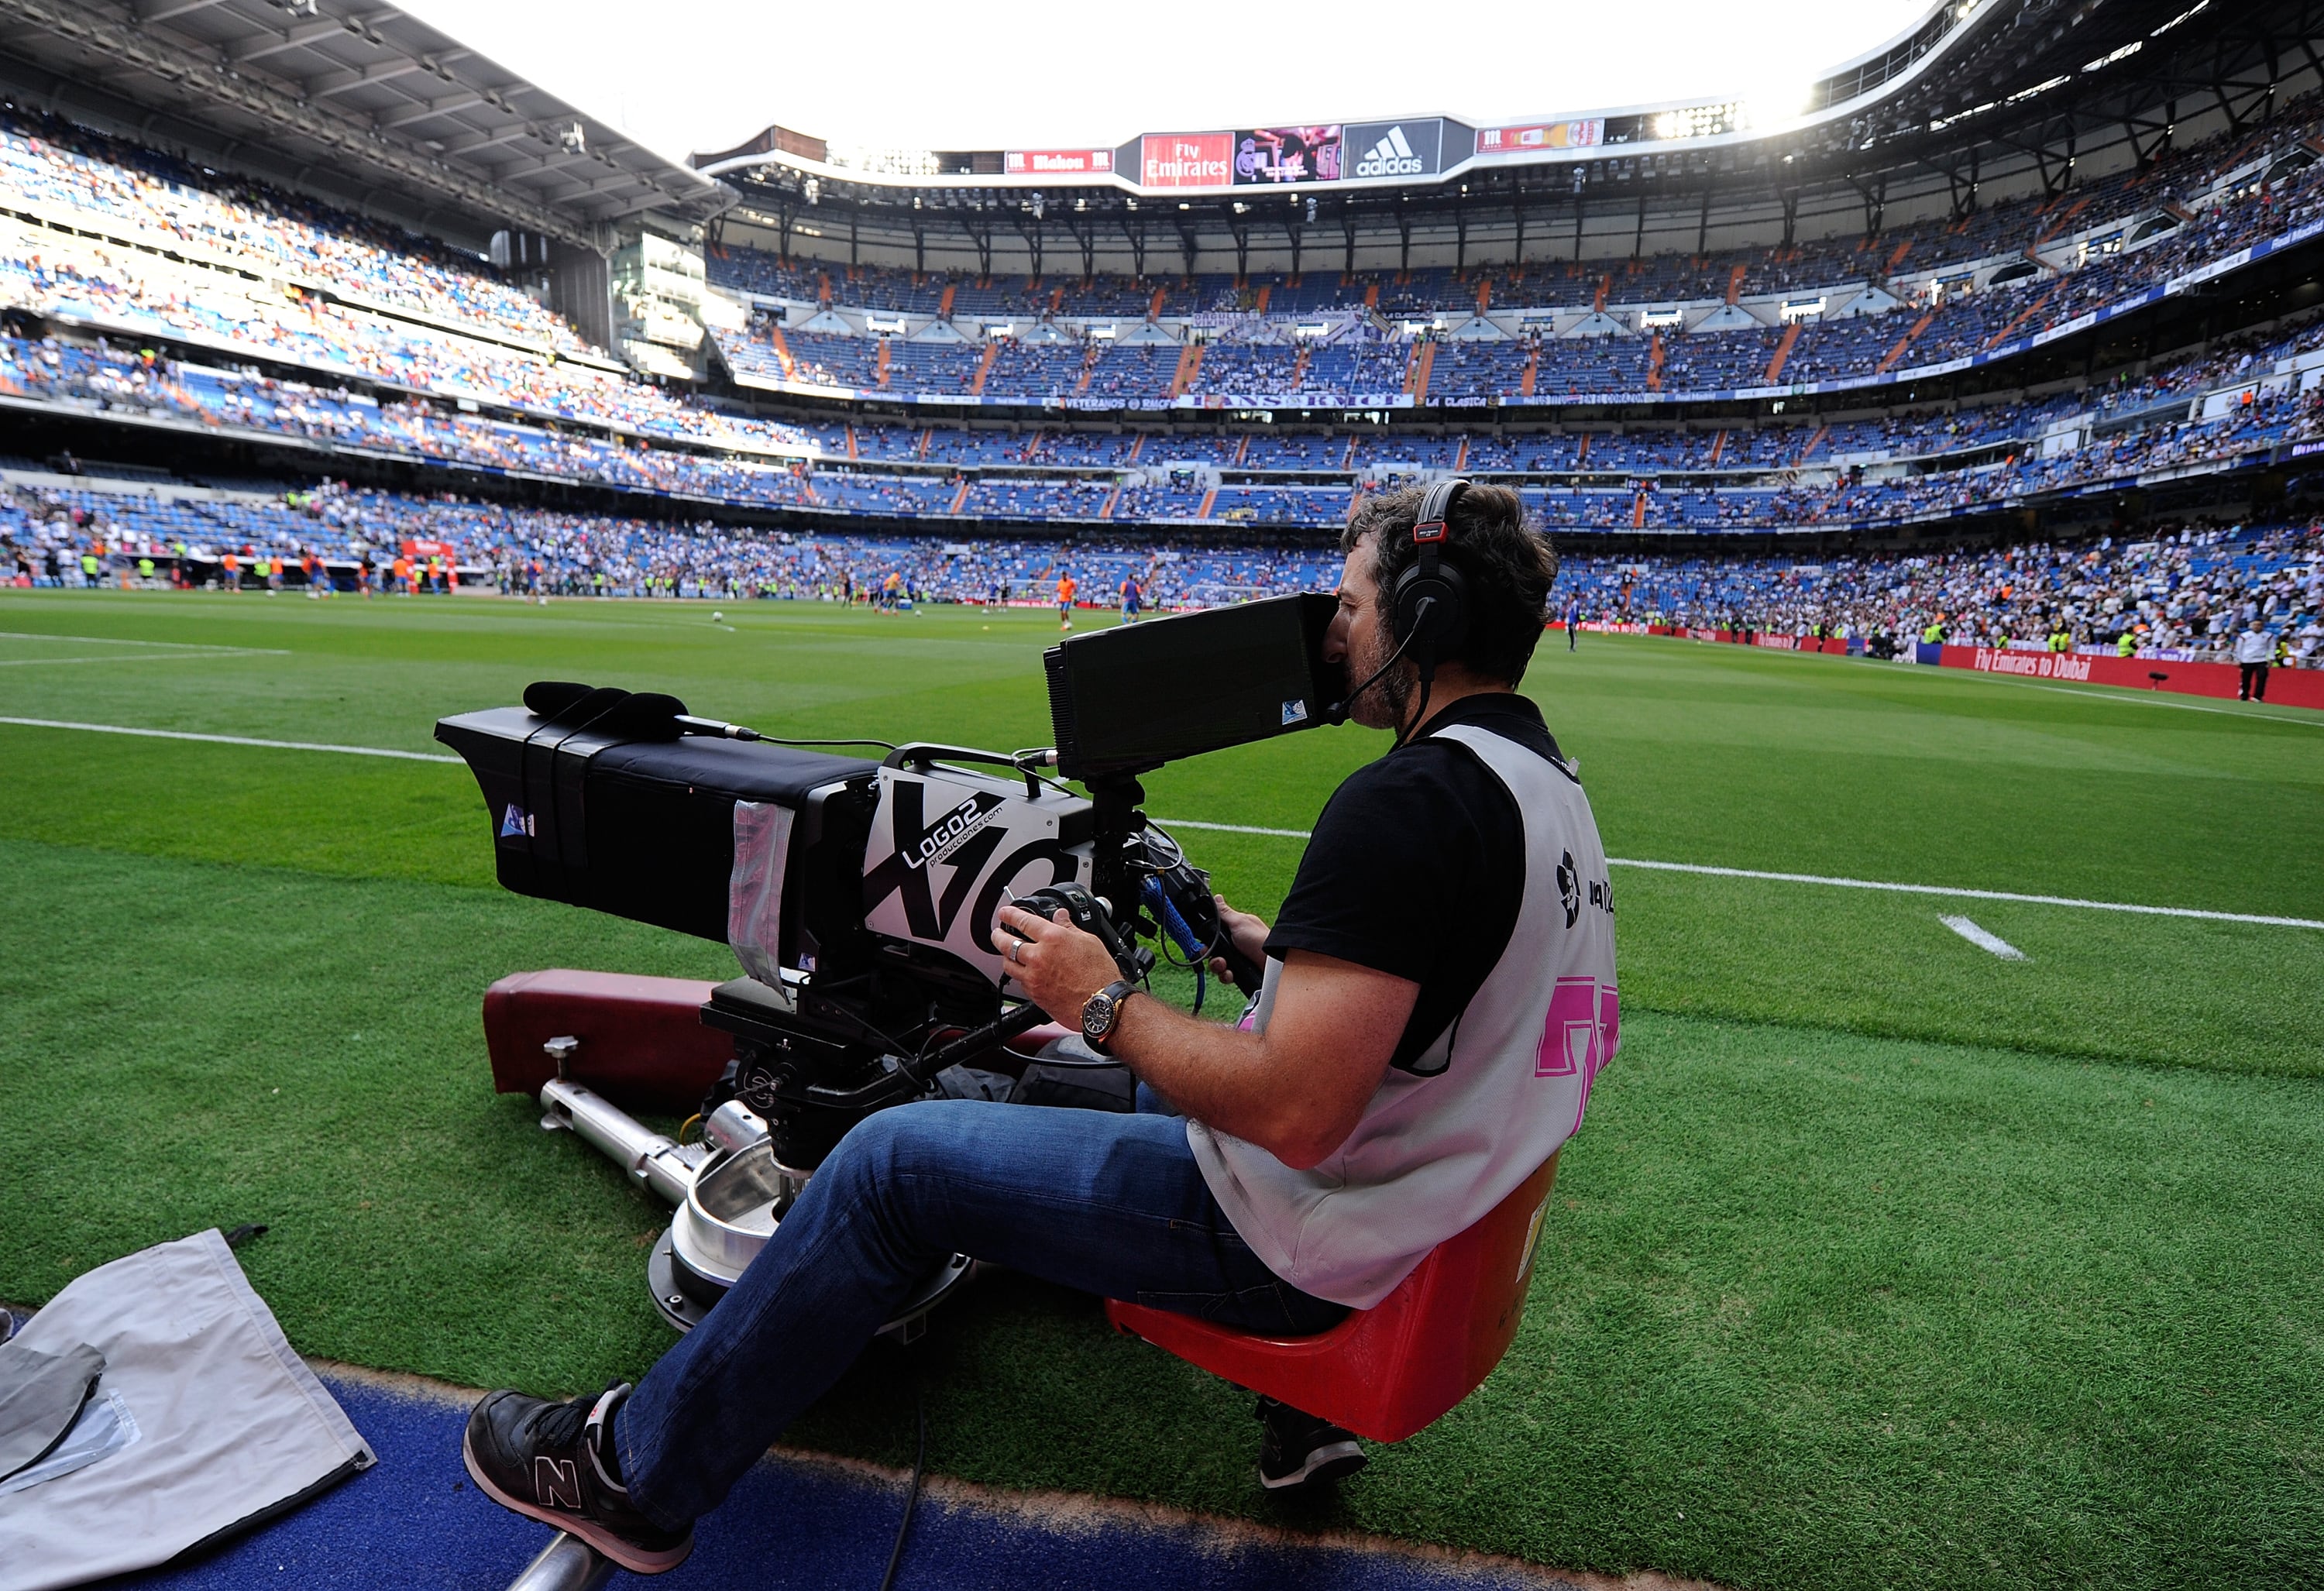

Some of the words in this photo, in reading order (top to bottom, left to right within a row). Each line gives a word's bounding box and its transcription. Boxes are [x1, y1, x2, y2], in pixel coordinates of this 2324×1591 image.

[1175, 143, 1199, 157] Fly
[1033, 154, 1084, 170] Mahou
[1147, 159, 1227, 177] Emirates
[1356, 157, 1422, 177] adidas
[1065, 398, 1126, 408] VETERANOS
[1425, 397, 1439, 407] LA
[1445, 397, 1487, 407] CLASICA
[1975, 648, 1992, 672] Fly
[1992, 649, 2037, 675] Emirates
[2038, 657, 2052, 677] to
[2053, 653, 2092, 681] Dubai
[902, 799, 982, 869] LOGO2
[535, 1456, 580, 1509] N
